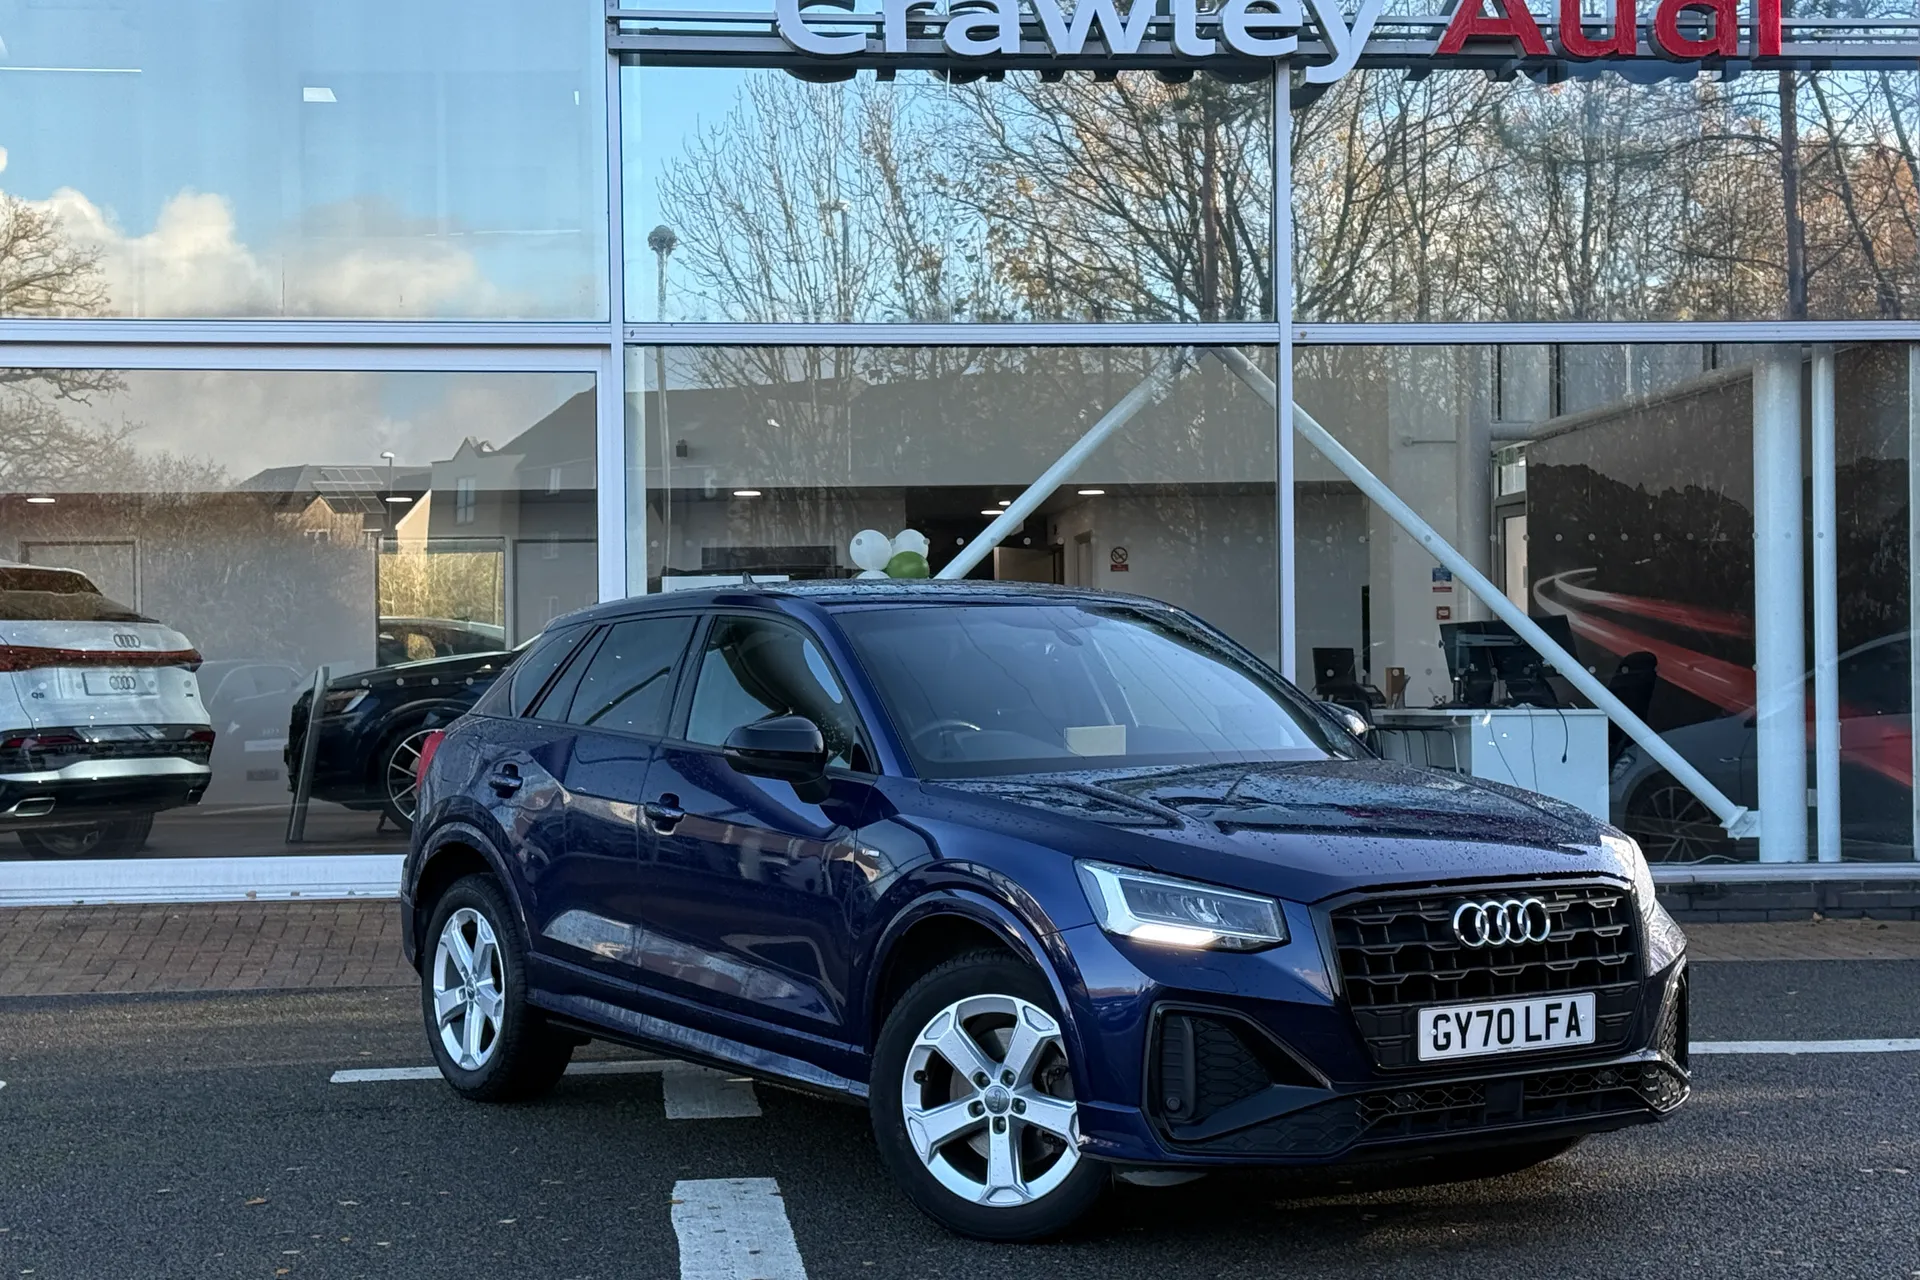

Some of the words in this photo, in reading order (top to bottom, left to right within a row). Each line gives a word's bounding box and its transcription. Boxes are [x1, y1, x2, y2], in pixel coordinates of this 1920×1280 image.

[776, 0, 1383, 84] Crawley
[1435, 0, 1784, 58] Audi
[1433, 1008, 1515, 1051] GY70
[1524, 1001, 1582, 1042] LFA
